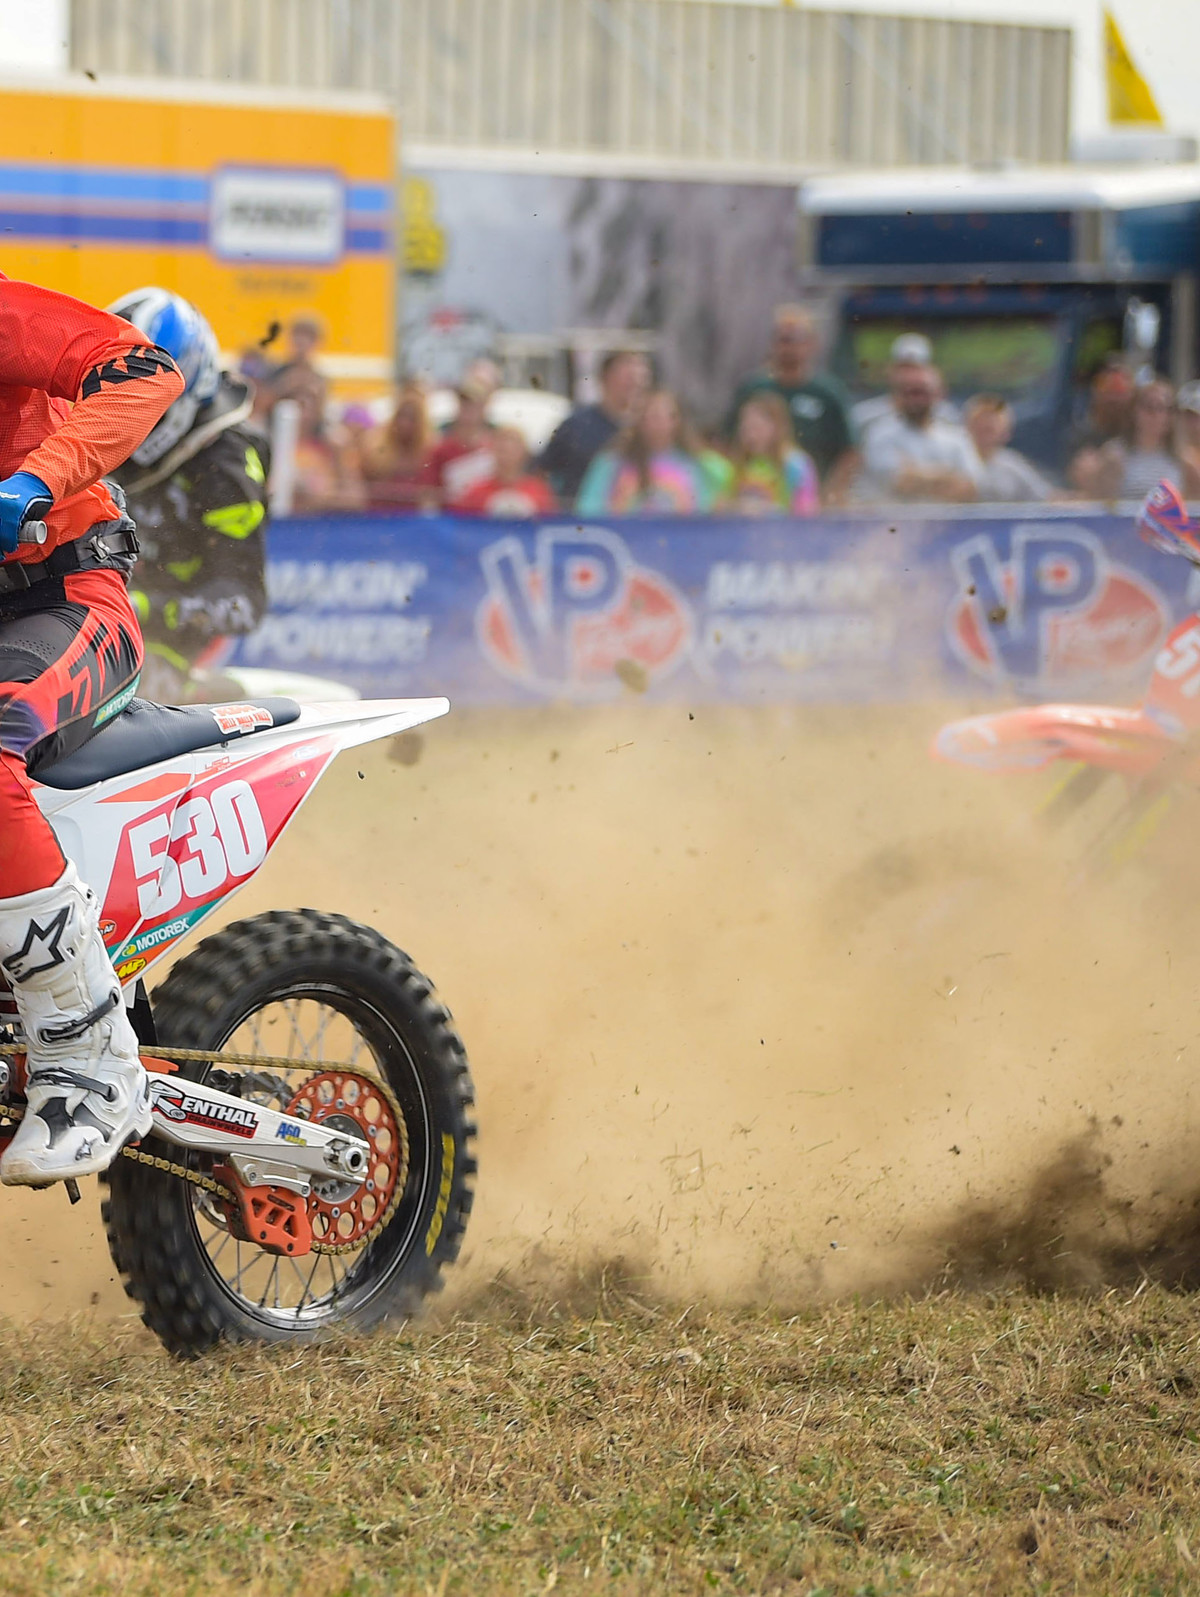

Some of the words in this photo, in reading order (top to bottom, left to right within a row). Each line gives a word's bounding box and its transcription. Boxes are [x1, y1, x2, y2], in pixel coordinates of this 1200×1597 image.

[480, 526, 630, 692] VP
[951, 522, 1100, 695] VP
[128, 779, 269, 920] 530
[115, 958, 145, 978] MF
[136, 916, 191, 951] MOTOREX
